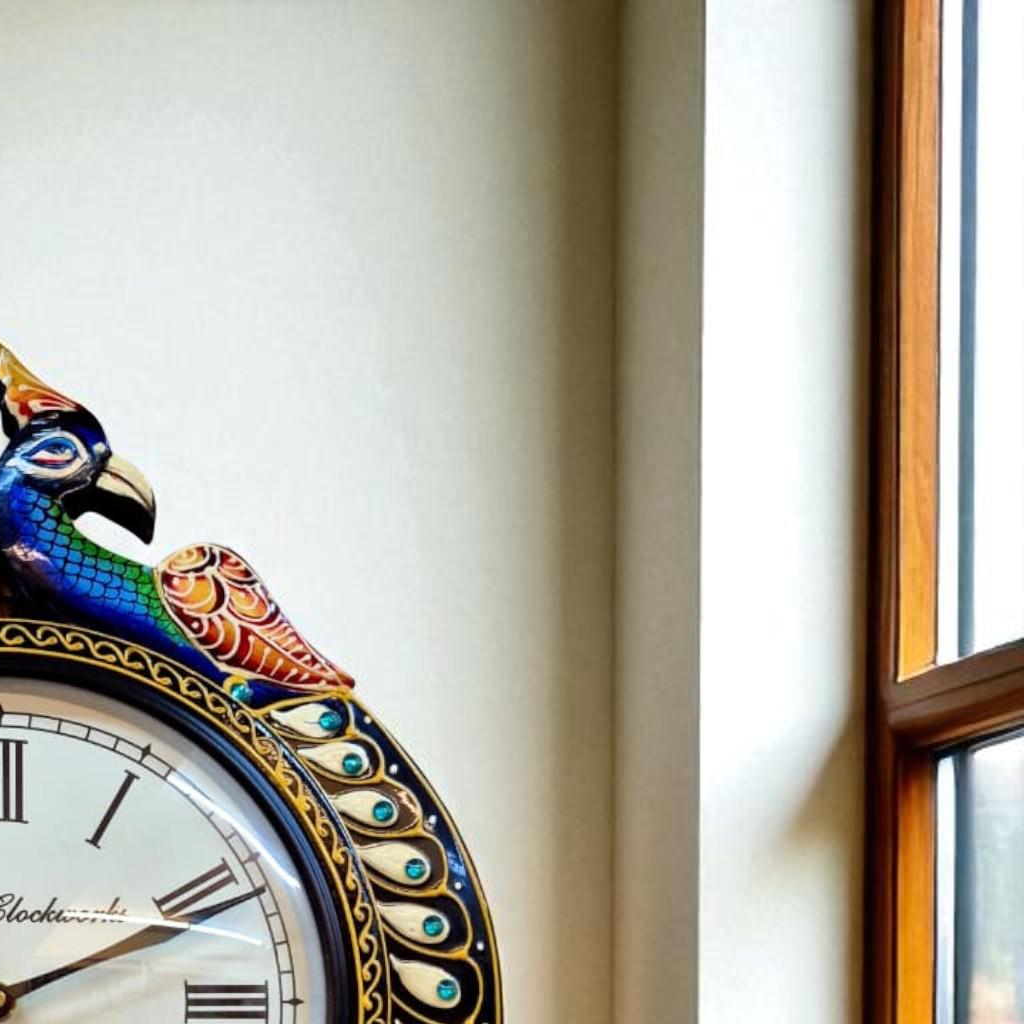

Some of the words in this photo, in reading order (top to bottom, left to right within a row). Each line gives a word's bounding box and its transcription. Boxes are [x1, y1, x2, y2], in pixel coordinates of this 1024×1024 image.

[85, 769, 140, 849] I
[151, 857, 239, 920] II
[184, 979, 268, 1024] III
